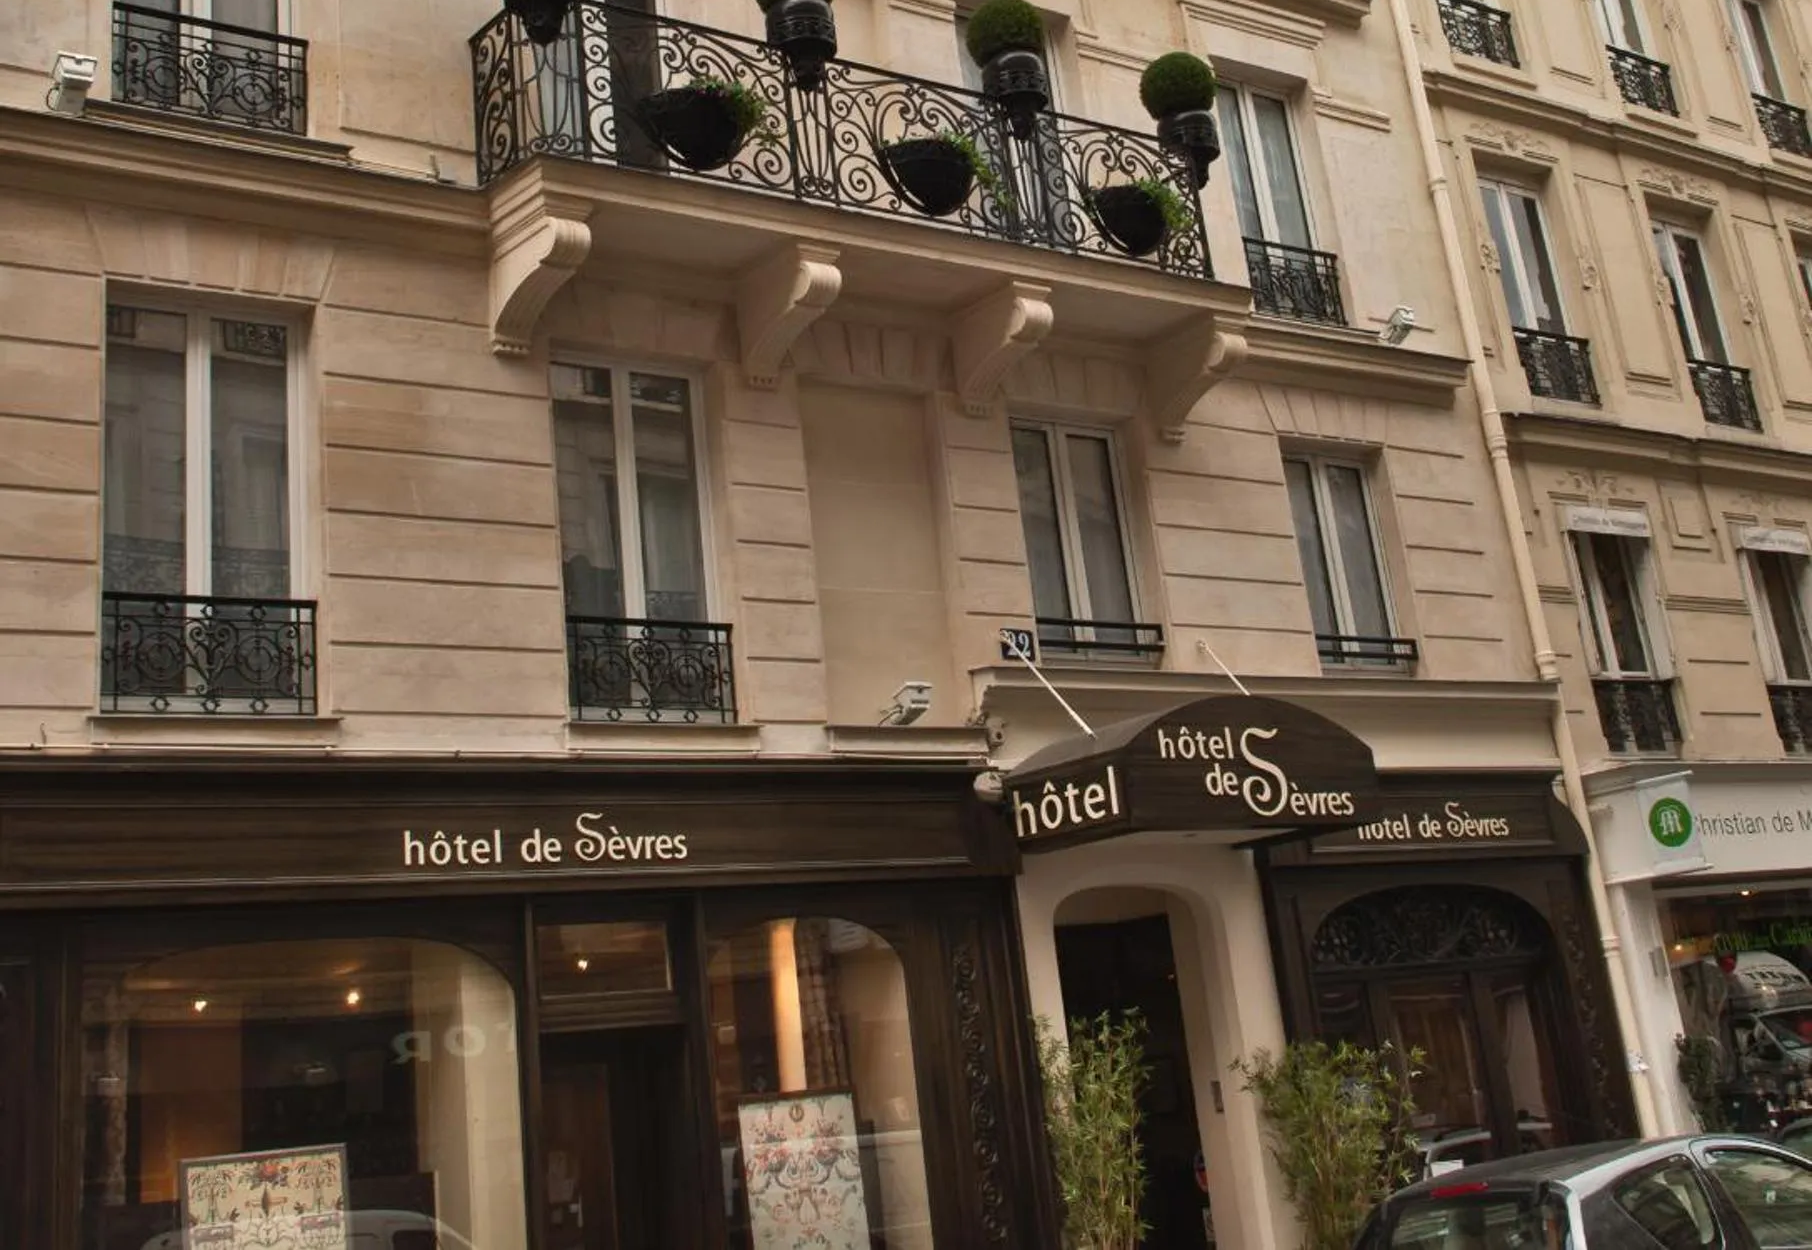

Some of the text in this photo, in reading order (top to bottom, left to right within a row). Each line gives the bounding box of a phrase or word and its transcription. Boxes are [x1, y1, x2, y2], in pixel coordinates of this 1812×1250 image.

[1158, 726, 1234, 759] hôtel
[1205, 727, 1355, 817] de Sèvres
[1012, 765, 1121, 838] hôtel
[1418, 812, 1443, 838] de
[1444, 801, 1510, 838] Sèvres
[1694, 812, 1767, 836] hristian
[1771, 812, 1795, 834] de
[404, 812, 688, 866] hôtel de Sèvres
